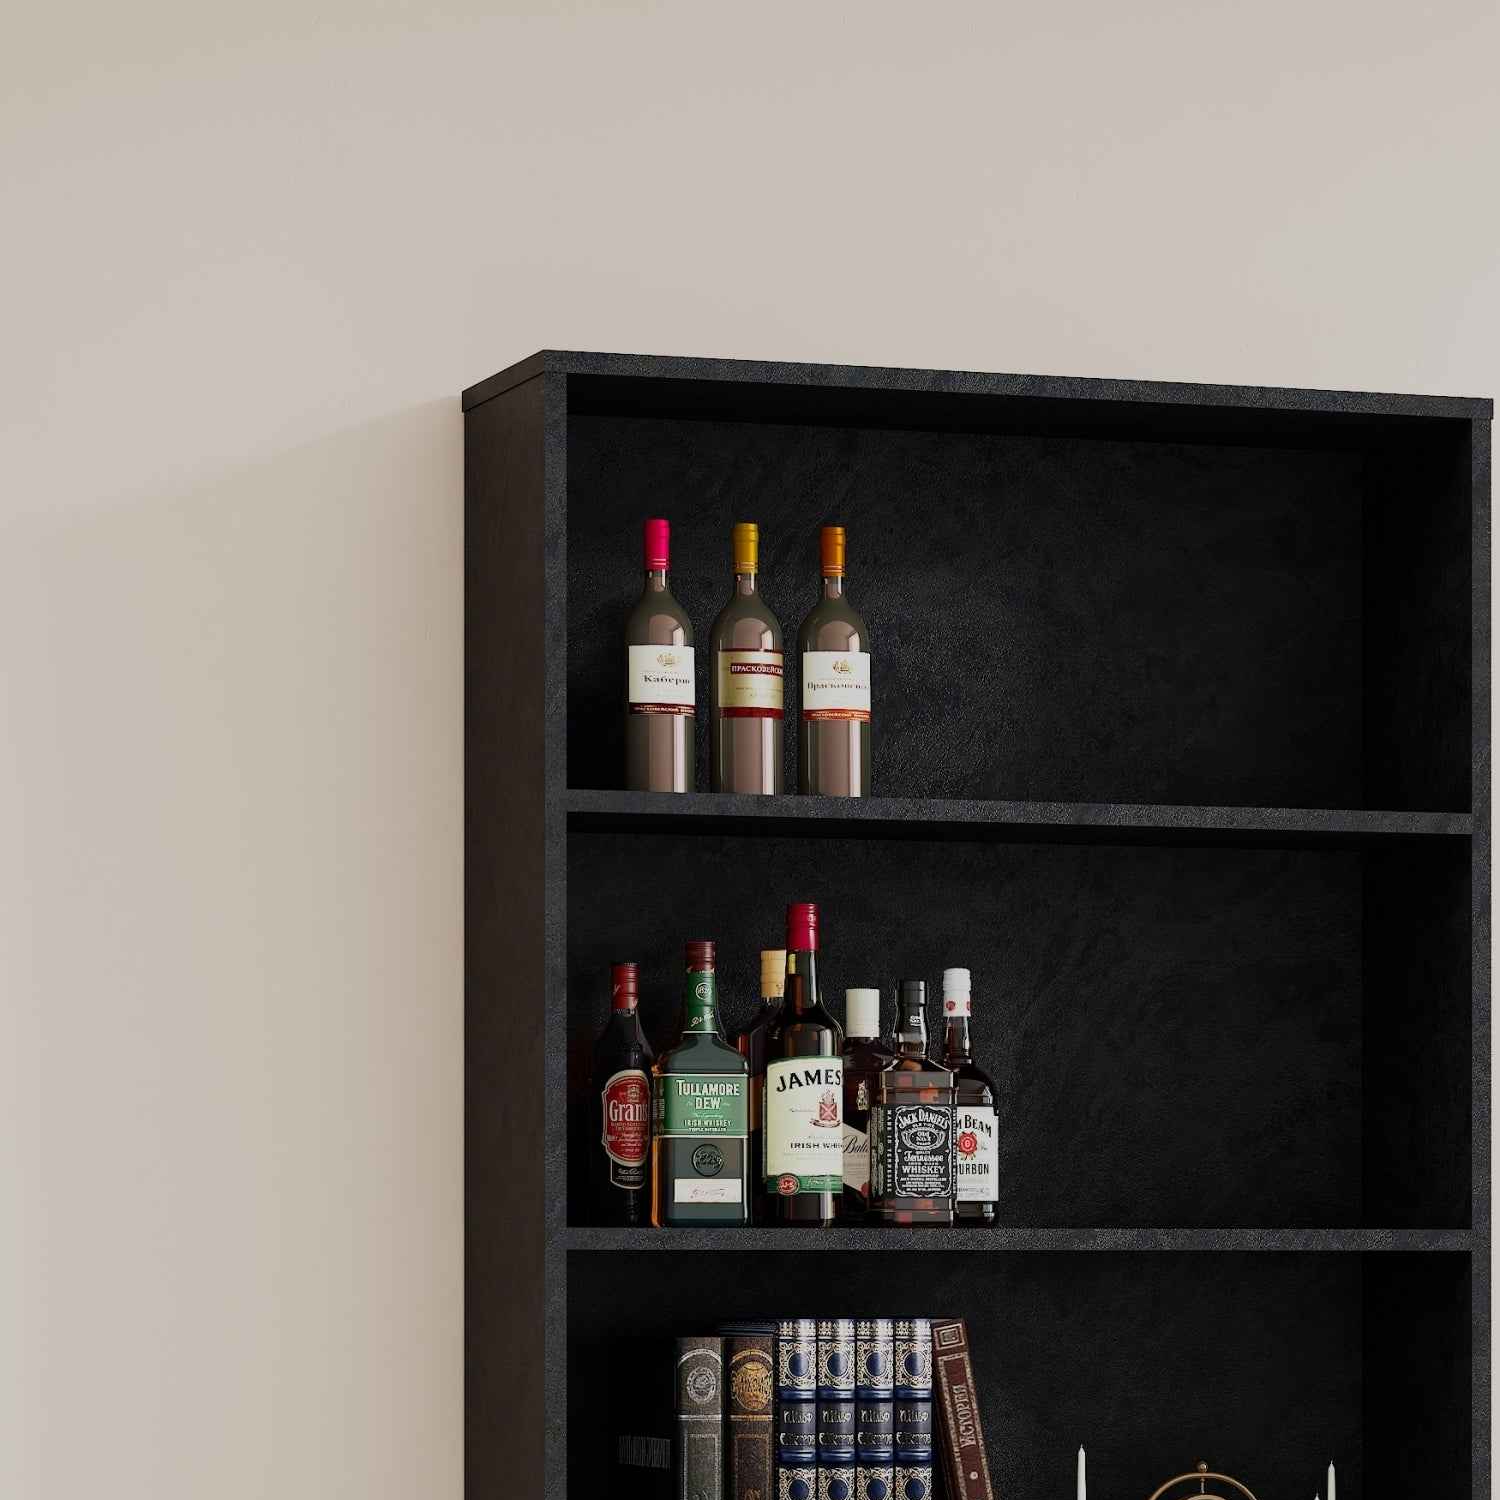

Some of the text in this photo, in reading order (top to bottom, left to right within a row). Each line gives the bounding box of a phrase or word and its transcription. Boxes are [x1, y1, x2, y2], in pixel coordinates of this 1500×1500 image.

[675, 1079, 741, 1097] TULLAMORE
[695, 1097, 721, 1110] DEW
[684, 1119, 732, 1127] IRISH WHISKEY
[964, 1114, 992, 1138] BEAM
[902, 1165, 945, 1174] WHISKEY
[958, 1163, 989, 1175] URBON
